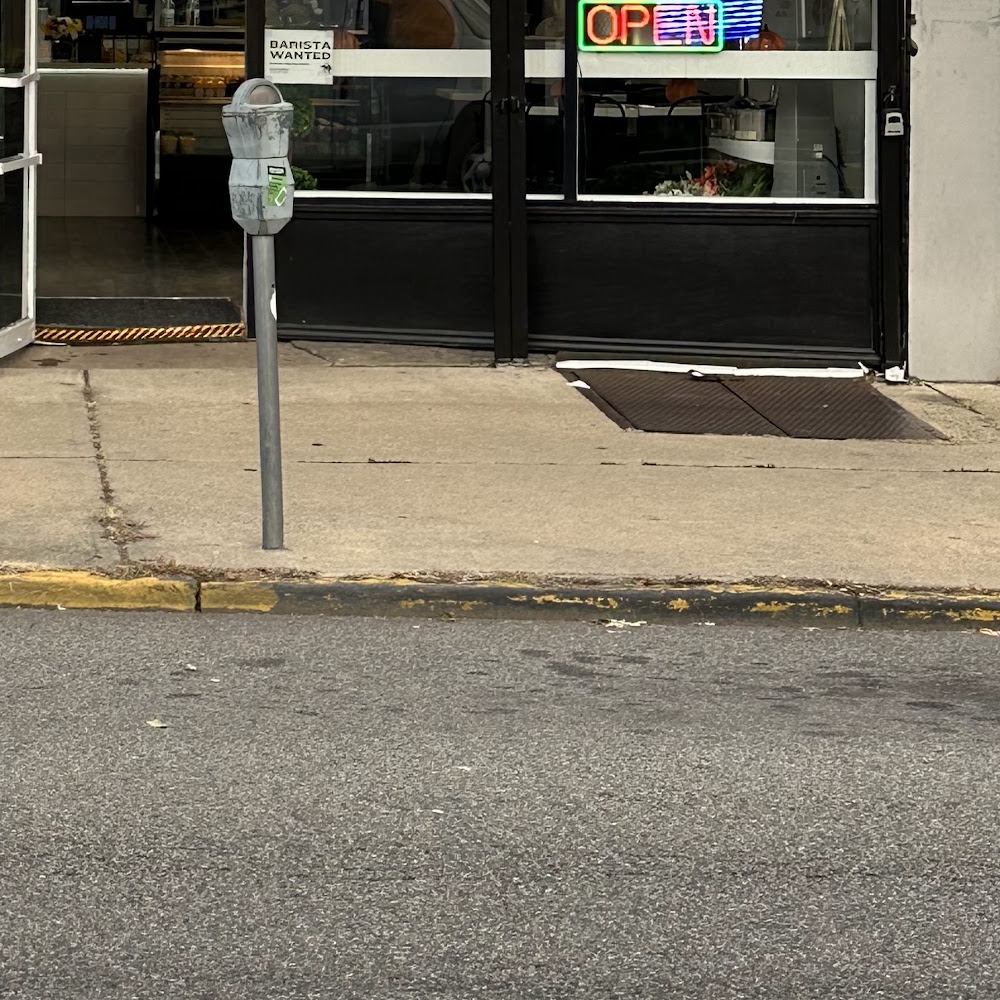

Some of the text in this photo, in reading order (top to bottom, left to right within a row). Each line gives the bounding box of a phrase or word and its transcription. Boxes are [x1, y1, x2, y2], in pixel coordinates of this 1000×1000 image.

[586, 4, 715, 46] OPEN
[270, 40, 331, 50] BARISTA
[270, 51, 331, 60] WANTED
